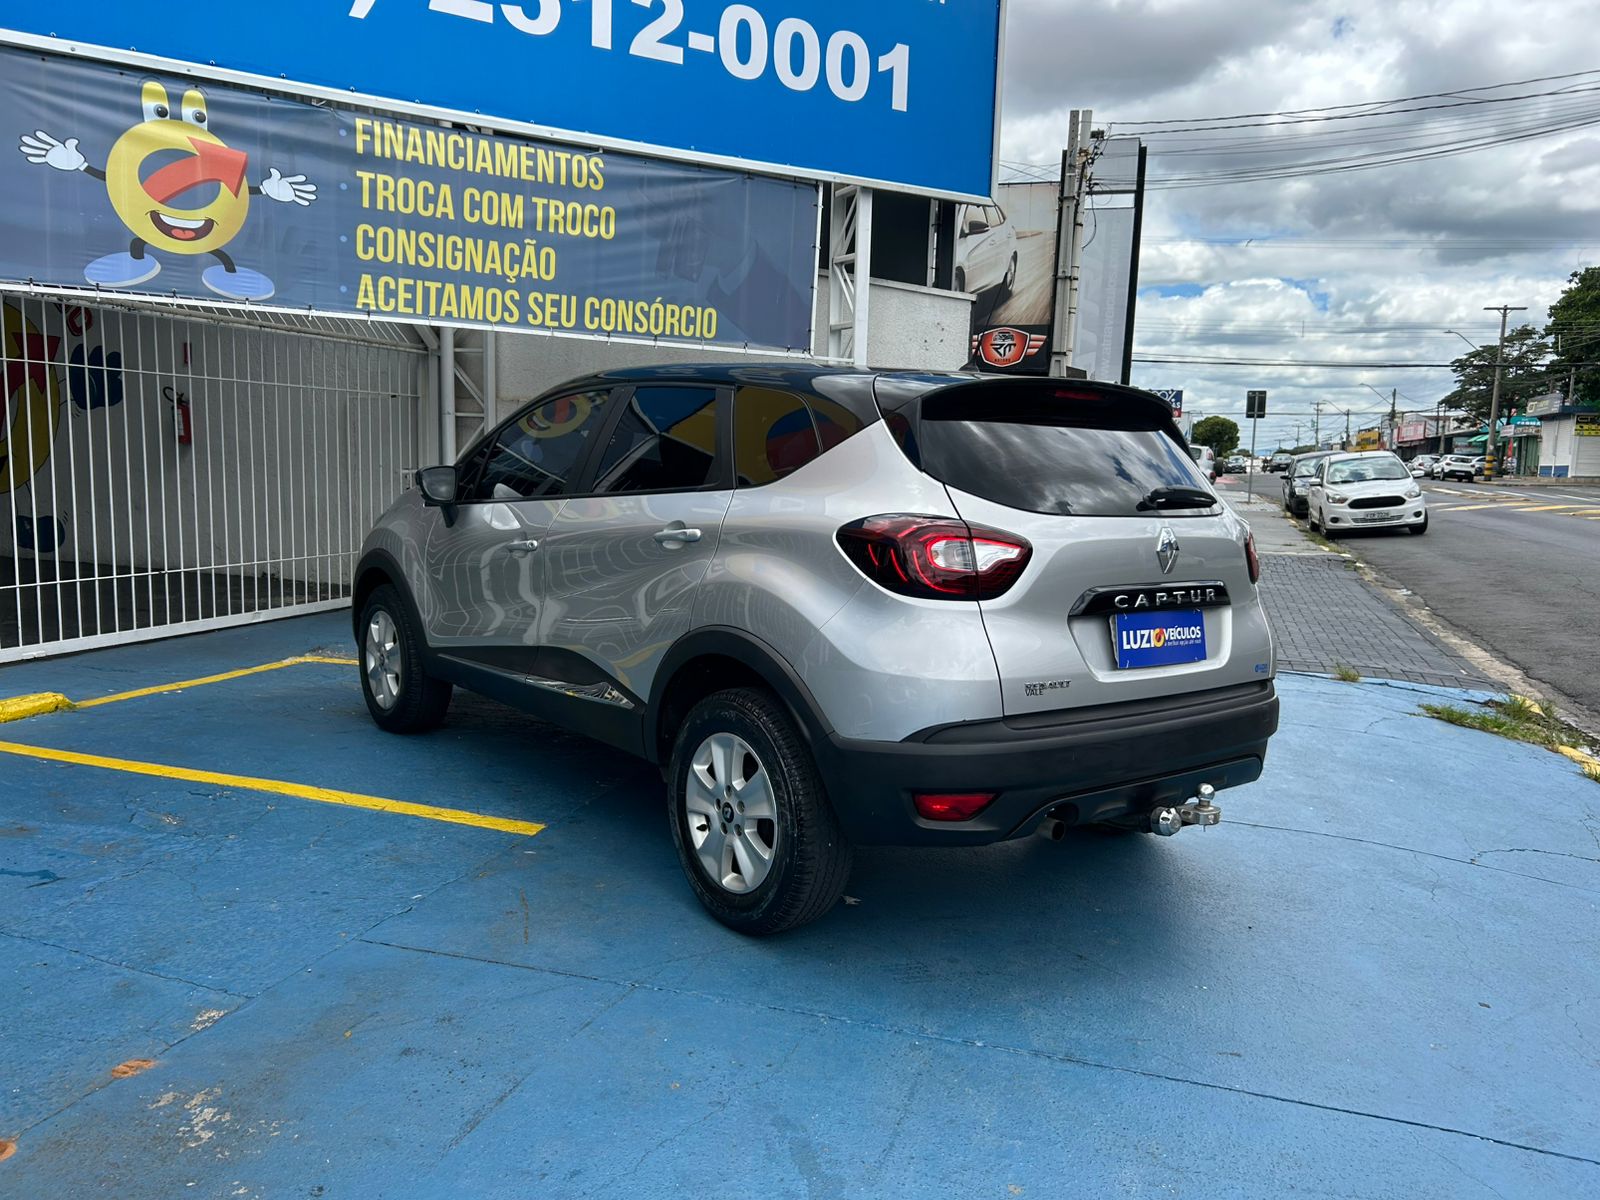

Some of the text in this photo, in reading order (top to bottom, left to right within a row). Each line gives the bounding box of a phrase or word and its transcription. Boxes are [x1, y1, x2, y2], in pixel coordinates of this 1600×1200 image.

[355, 118, 605, 191] FINANCIAMENTOS
[356, 170, 616, 240] TROCA COM TROCO
[356, 223, 556, 284] CONSIGNAÇÃO
[356, 274, 718, 339] ACEITAMOS SEU CONSÓRCIO
[1114, 589, 1216, 608] CAPTUR
[1122, 625, 1202, 650] LUZIO VEÍCULOS
[1025, 689, 1044, 697] VALE
